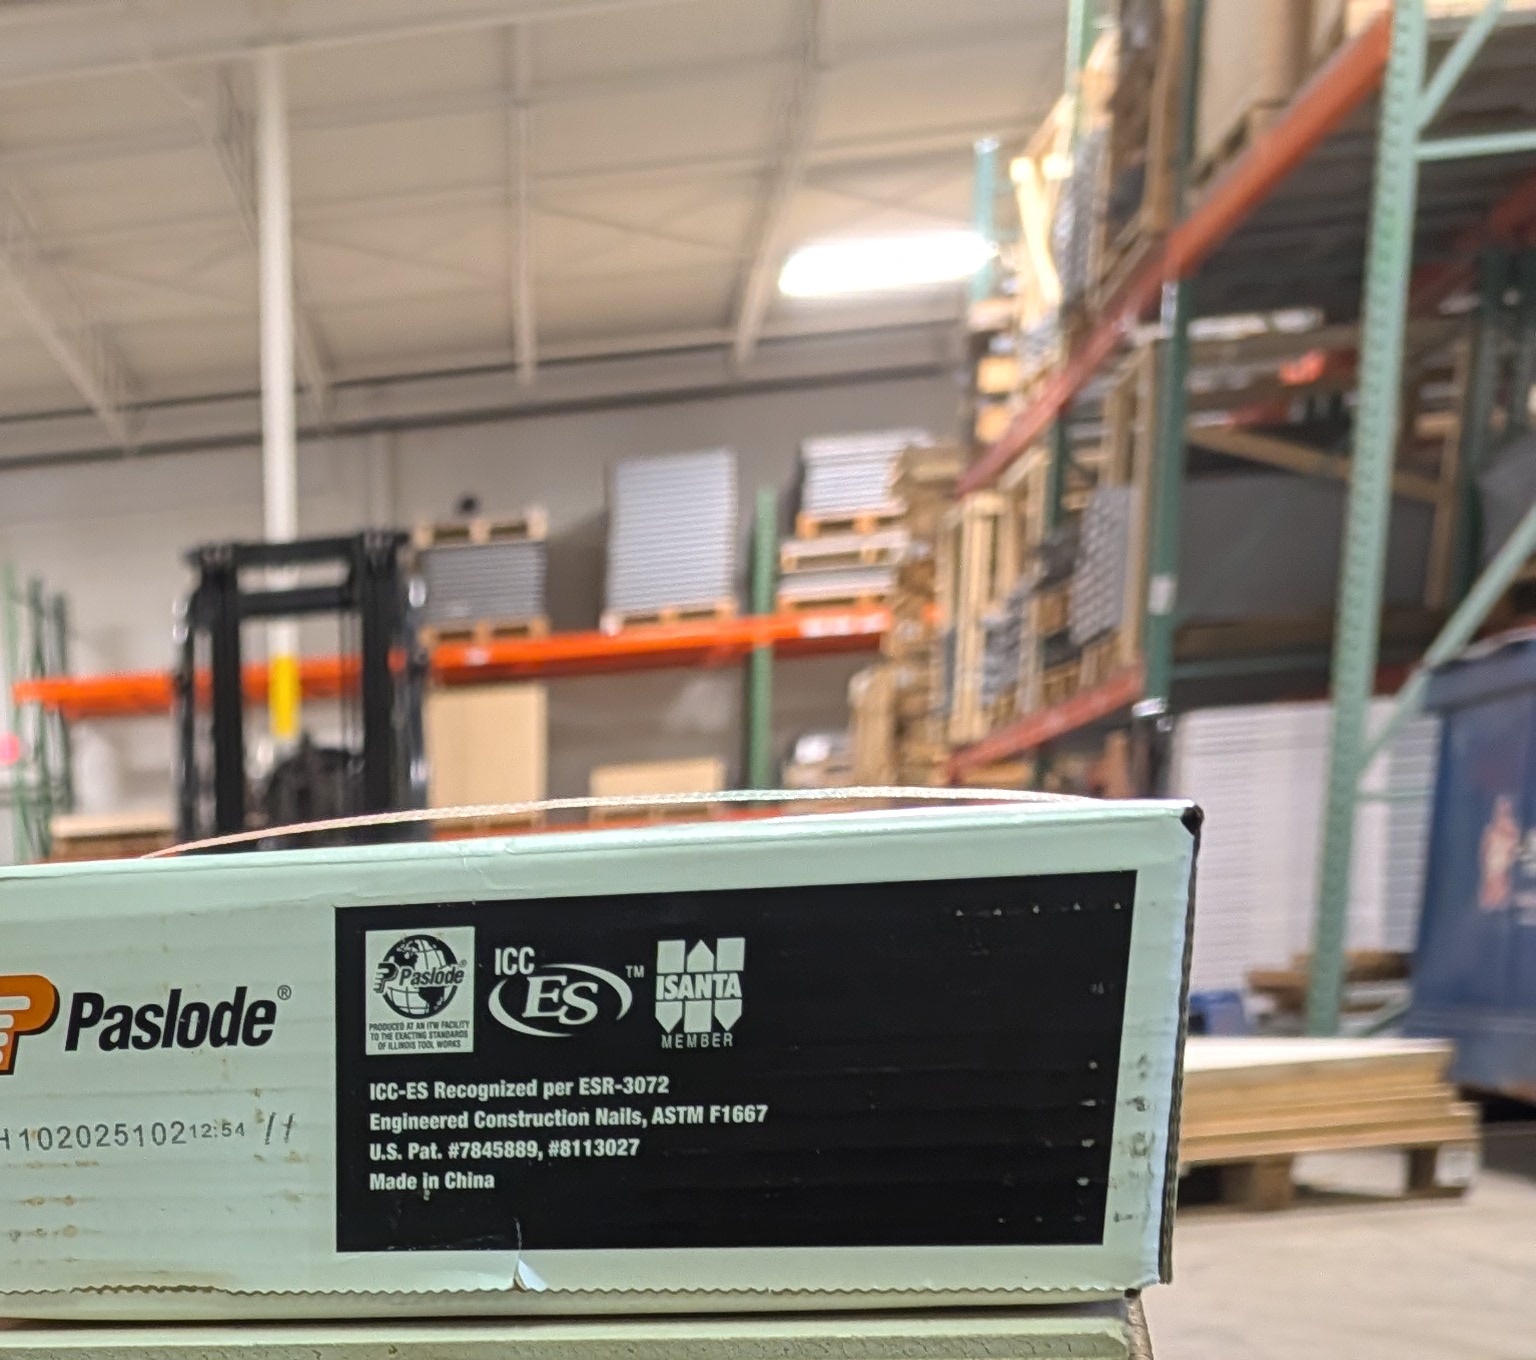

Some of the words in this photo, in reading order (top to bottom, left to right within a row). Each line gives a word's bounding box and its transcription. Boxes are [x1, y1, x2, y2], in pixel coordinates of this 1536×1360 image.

[494, 946, 535, 976] ICC
[399, 967, 464, 986] Paslode
[655, 972, 742, 1000] ISANTA
[521, 975, 599, 1025] ES
[369, 1021, 404, 1031] PRODUCED
[661, 1032, 733, 1049] MEMBER
[369, 1081, 429, 1101] ICC-ES
[433, 1078, 538, 1102] Recognized
[543, 1081, 574, 1100] per
[578, 1075, 670, 1096] ESR-3072
[369, 1110, 469, 1134] Engineered
[474, 1108, 590, 1129] Construction
[595, 1107, 648, 1129] Nails,
[651, 1105, 704, 1125] ASTM
[709, 1104, 769, 1124] F1667
[369, 1142, 403, 1161] U.S.
[407, 1141, 443, 1160] Pat.
[448, 1140, 544, 1161] #7845889,
[547, 1138, 641, 1158] #8113027
[369, 1172, 417, 1191] Made
[422, 1171, 439, 1190] in
[444, 1170, 495, 1189] China
